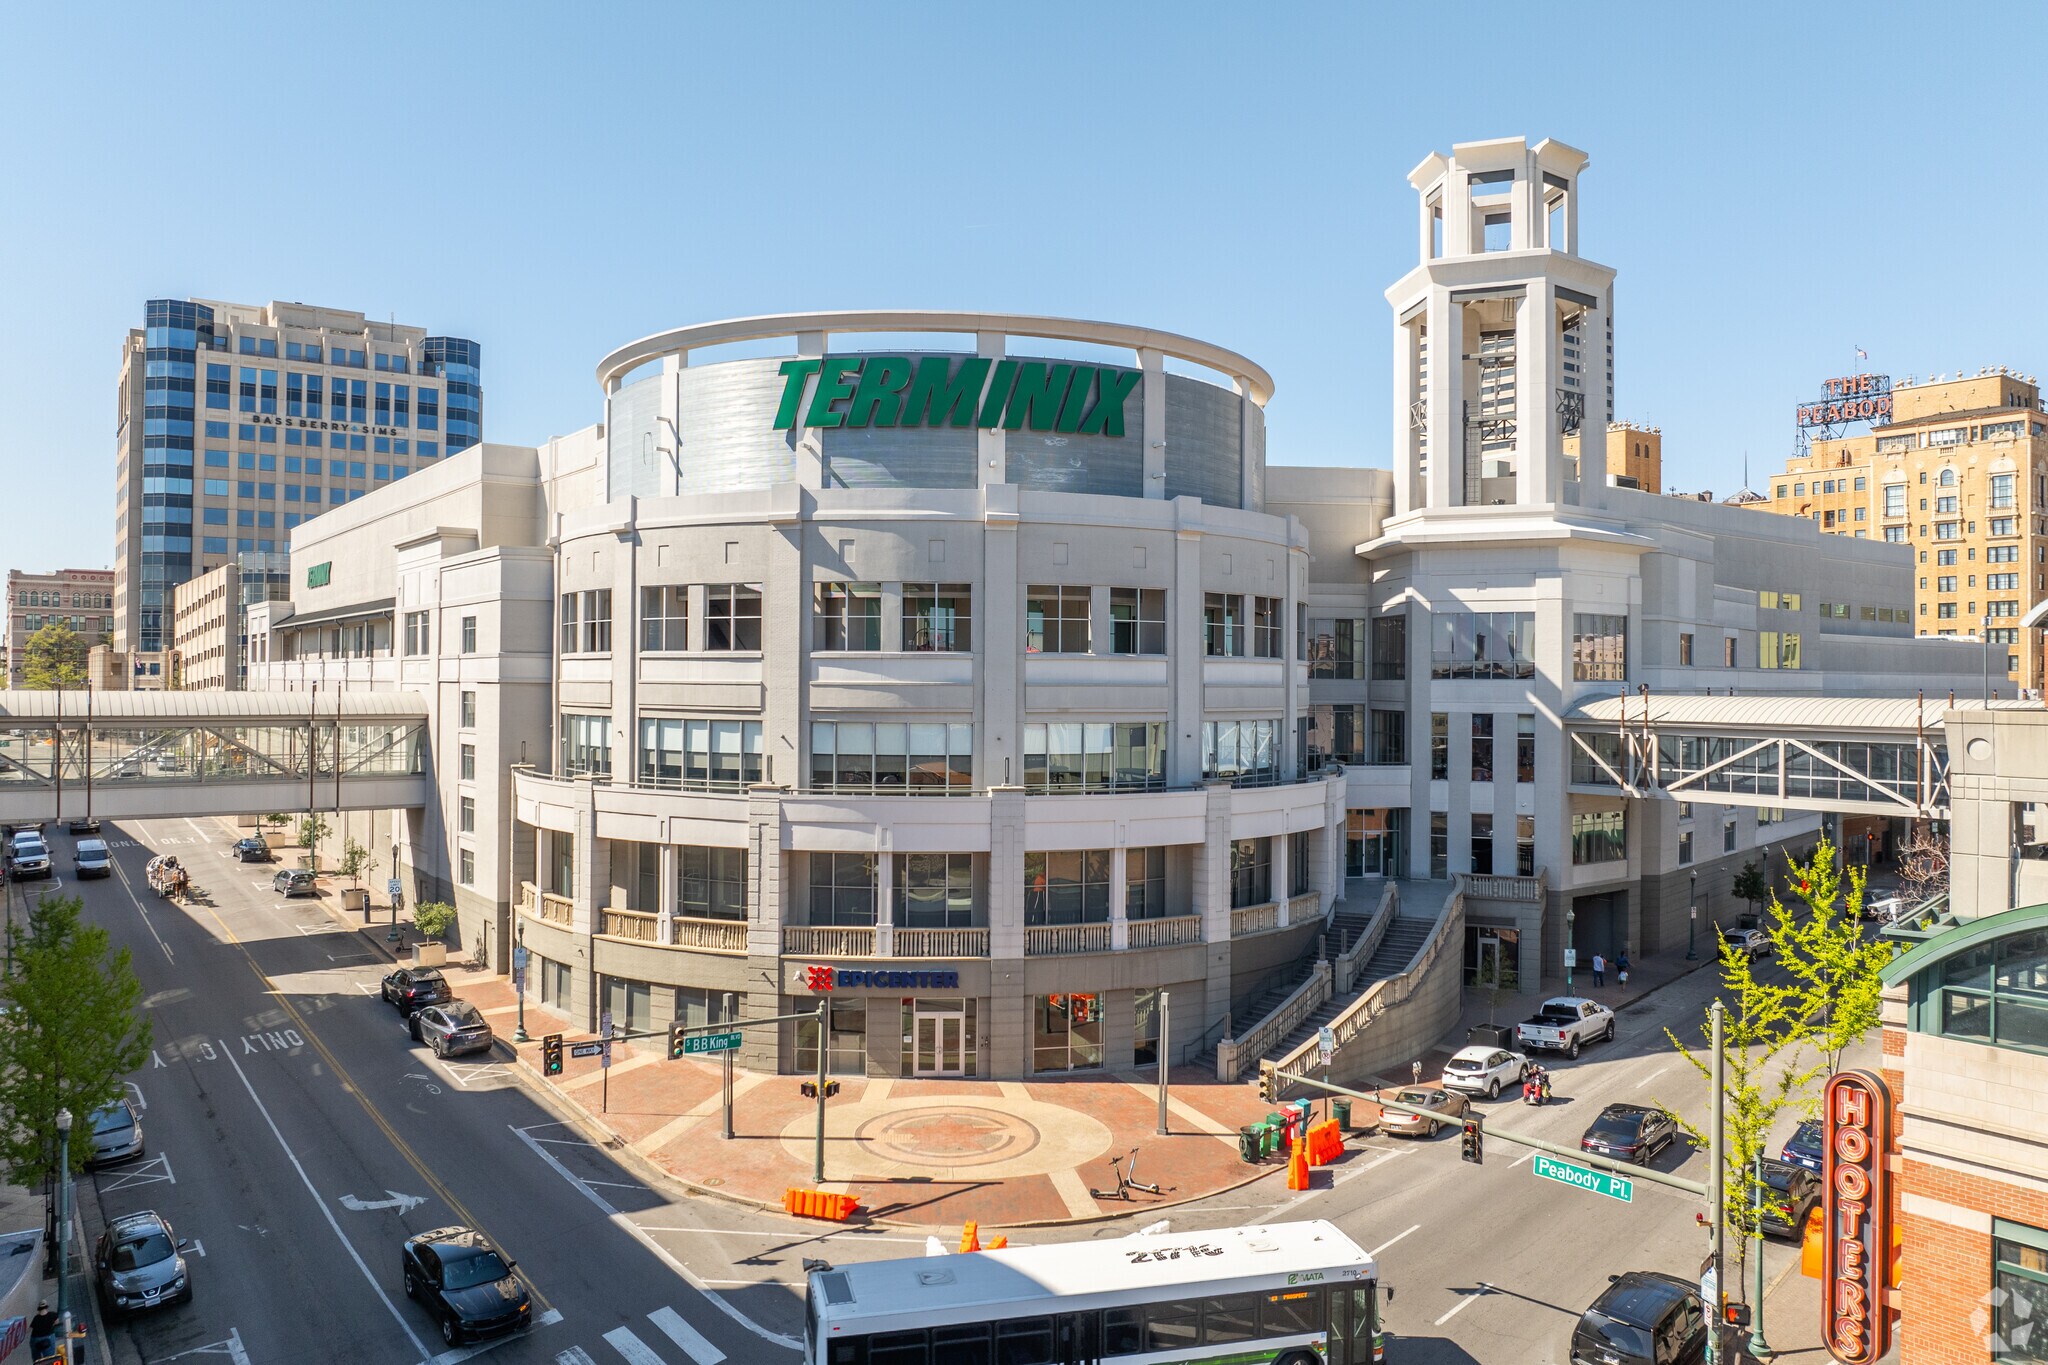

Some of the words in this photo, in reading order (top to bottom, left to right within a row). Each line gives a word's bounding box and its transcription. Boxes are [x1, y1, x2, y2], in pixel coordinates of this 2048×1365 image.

[1825, 373, 1873, 395] THE
[773, 356, 1143, 437] TERMINIX
[1797, 397, 1890, 425] PEABOD
[252, 415, 293, 426] BASS
[299, 419, 349, 431] BERRY
[362, 426, 397, 436] SIMS
[838, 970, 959, 988] EPICENTER
[240, 1029, 304, 1055] ONLY
[709, 1036, 728, 1049] King
[1538, 1158, 1601, 1191] Peabody
[1609, 1178, 1629, 1198] Pl.
[1834, 1084, 1870, 1357] HOOTERS
[1302, 1272, 1325, 1282] MATA
[1342, 1269, 1357, 1277] 2710
[1283, 1291, 1308, 1300] PROSPECT
